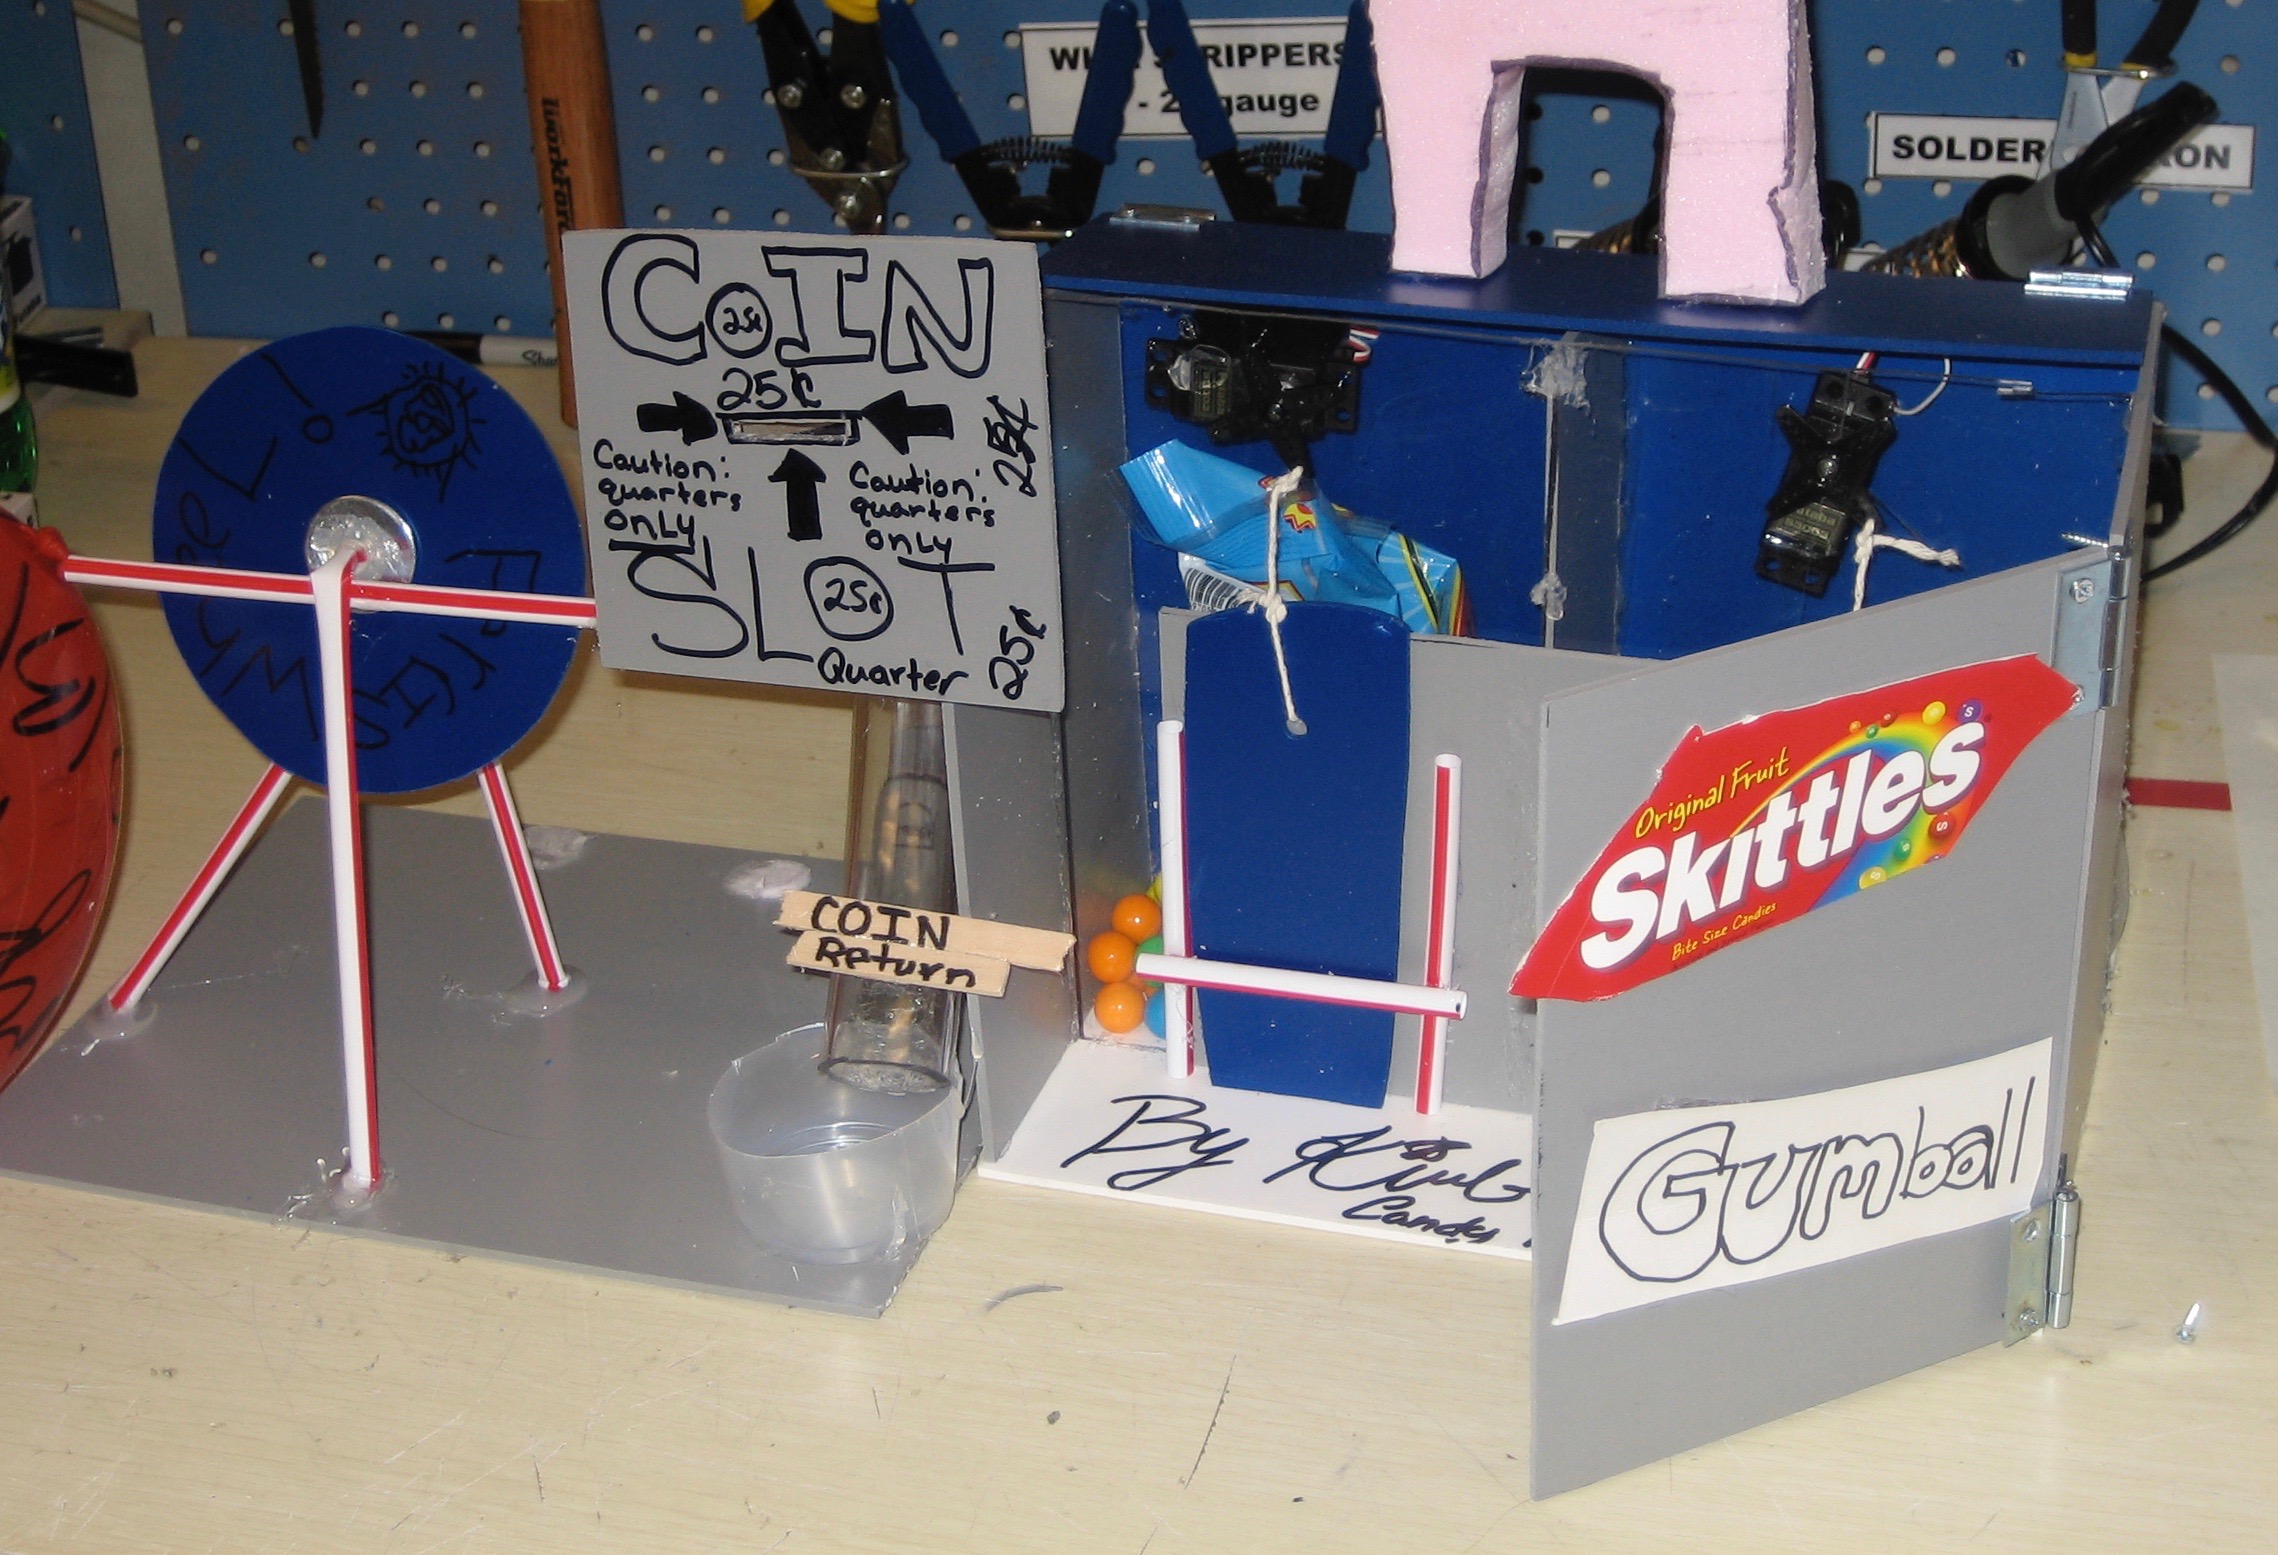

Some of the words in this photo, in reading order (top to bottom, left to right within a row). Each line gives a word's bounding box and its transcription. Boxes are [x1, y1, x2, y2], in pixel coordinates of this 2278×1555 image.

[1892, 134, 2047, 164] SOLDER
[2160, 143, 2232, 170] ON
[592, 437, 730, 483] Caution:
[597, 477, 742, 513] quarters
[850, 495, 996, 528] quarters
[627, 535, 997, 662] SLOT
[816, 646, 971, 696] Quarter
[1634, 774, 1726, 839] Original
[1729, 746, 1790, 799] Fruit
[1580, 720, 1987, 973] Skittles
[810, 895, 951, 951] COIN
[1671, 938, 1699, 962] Bite
[1702, 926, 1728, 945] Size
[1731, 902, 1777, 931] Candies
[814, 935, 977, 989] Return
[1060, 1094, 1250, 1192] By
[1599, 1075, 2036, 1284] Gumball
